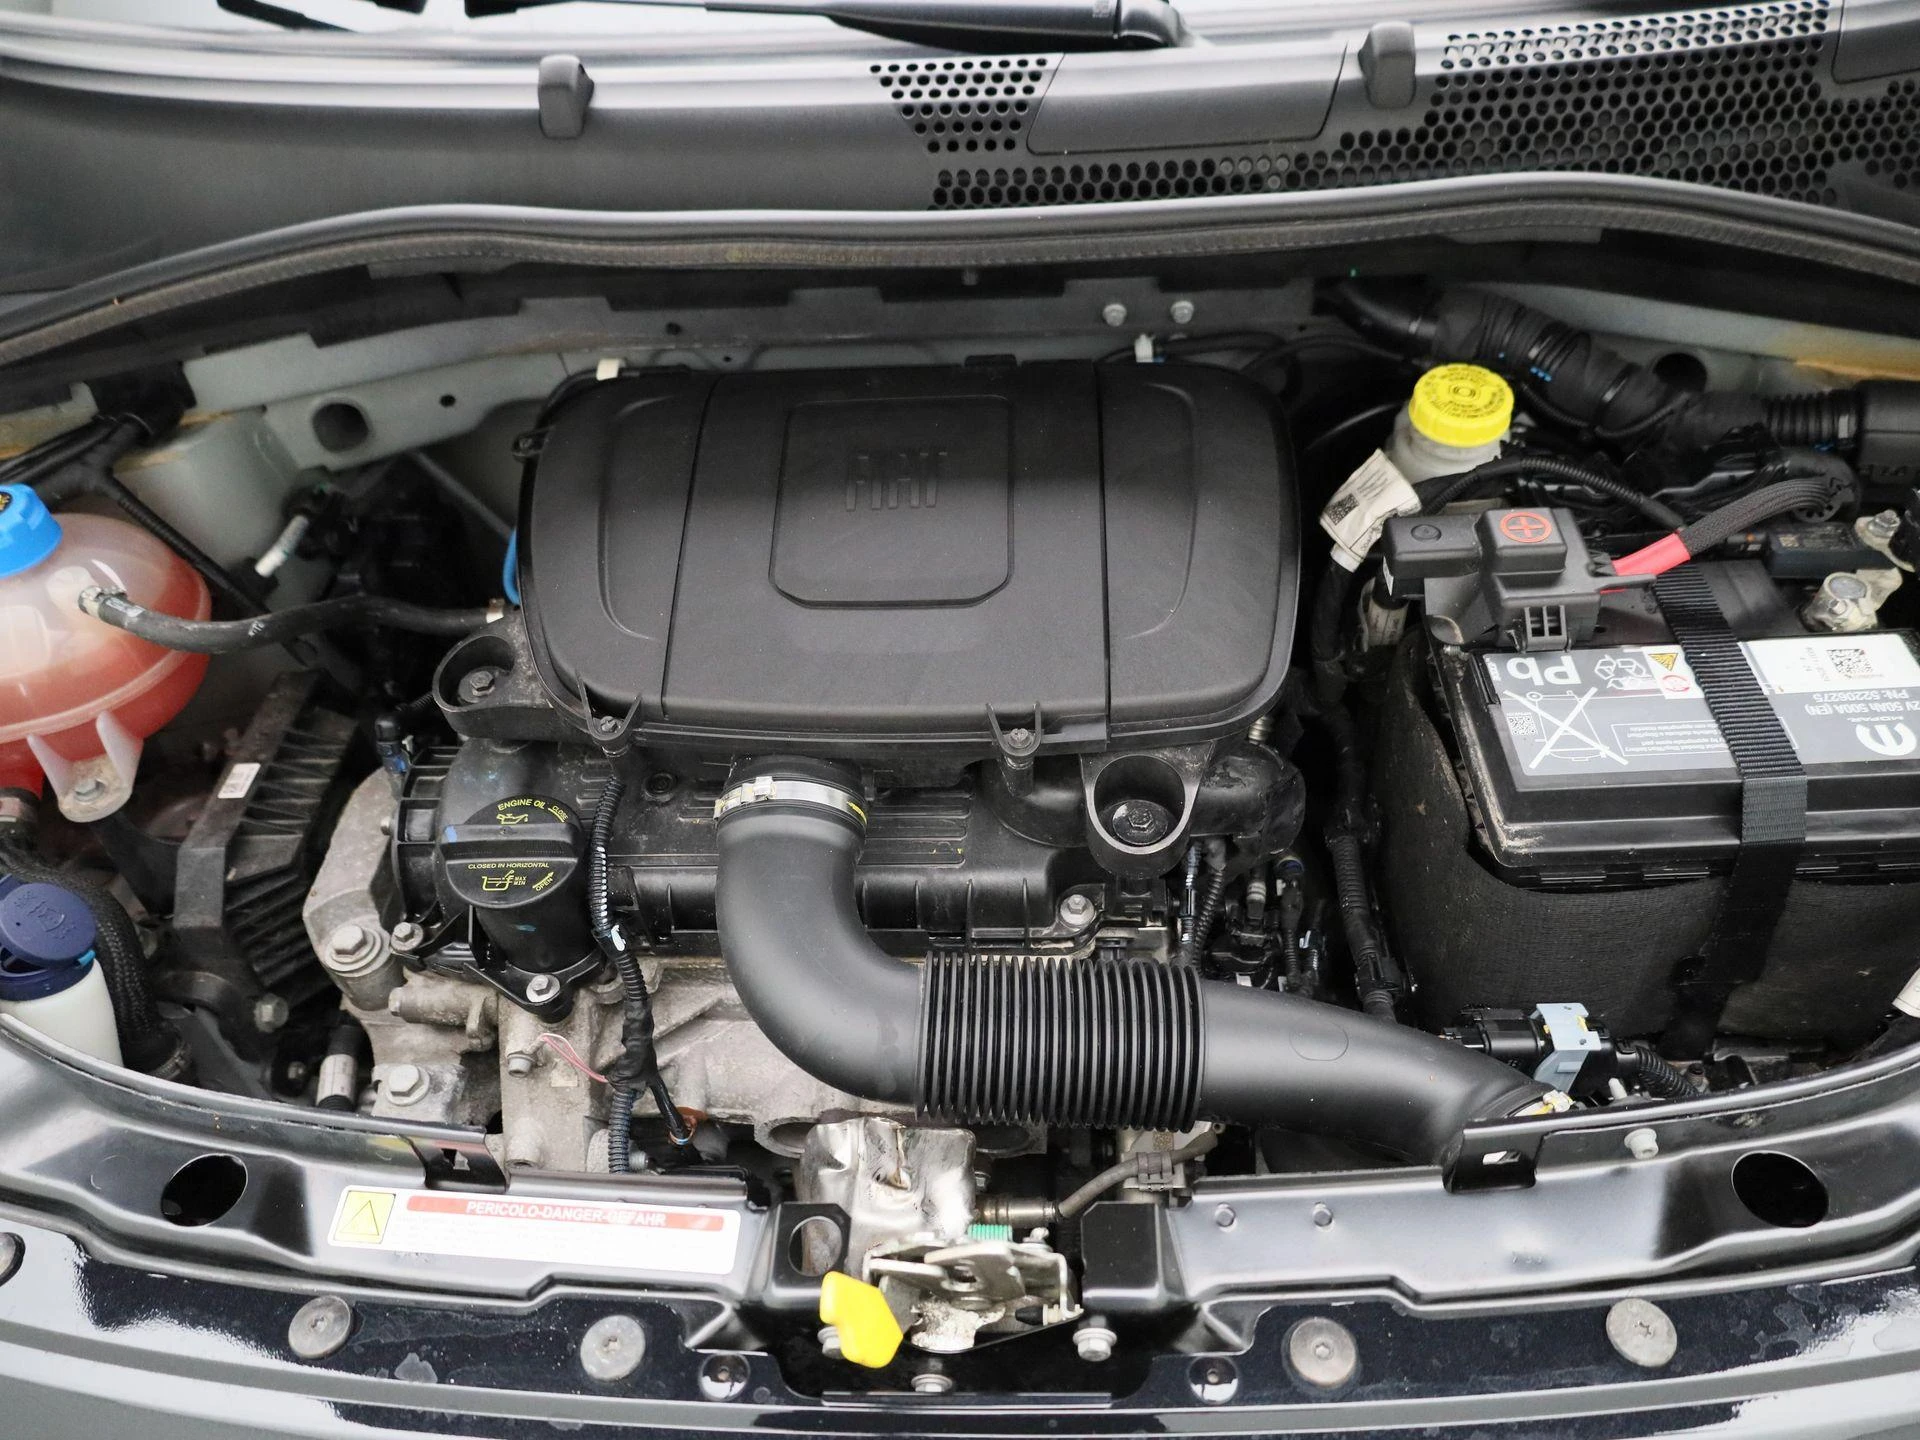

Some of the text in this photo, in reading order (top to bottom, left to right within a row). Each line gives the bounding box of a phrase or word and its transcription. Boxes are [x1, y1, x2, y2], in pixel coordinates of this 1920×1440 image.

[844, 450, 949, 512] FIAT
[1506, 655, 1582, 686] Pb
[1812, 688, 1909, 703] PN: 52206275
[1804, 703, 1834, 716] (EN)
[1833, 703, 1869, 714] 500A
[1869, 701, 1904, 712] 50Ah
[497, 798, 546, 811] ENGINE OIL
[552, 805, 569, 820] CLOSE
[535, 877, 554, 892] OPEN
